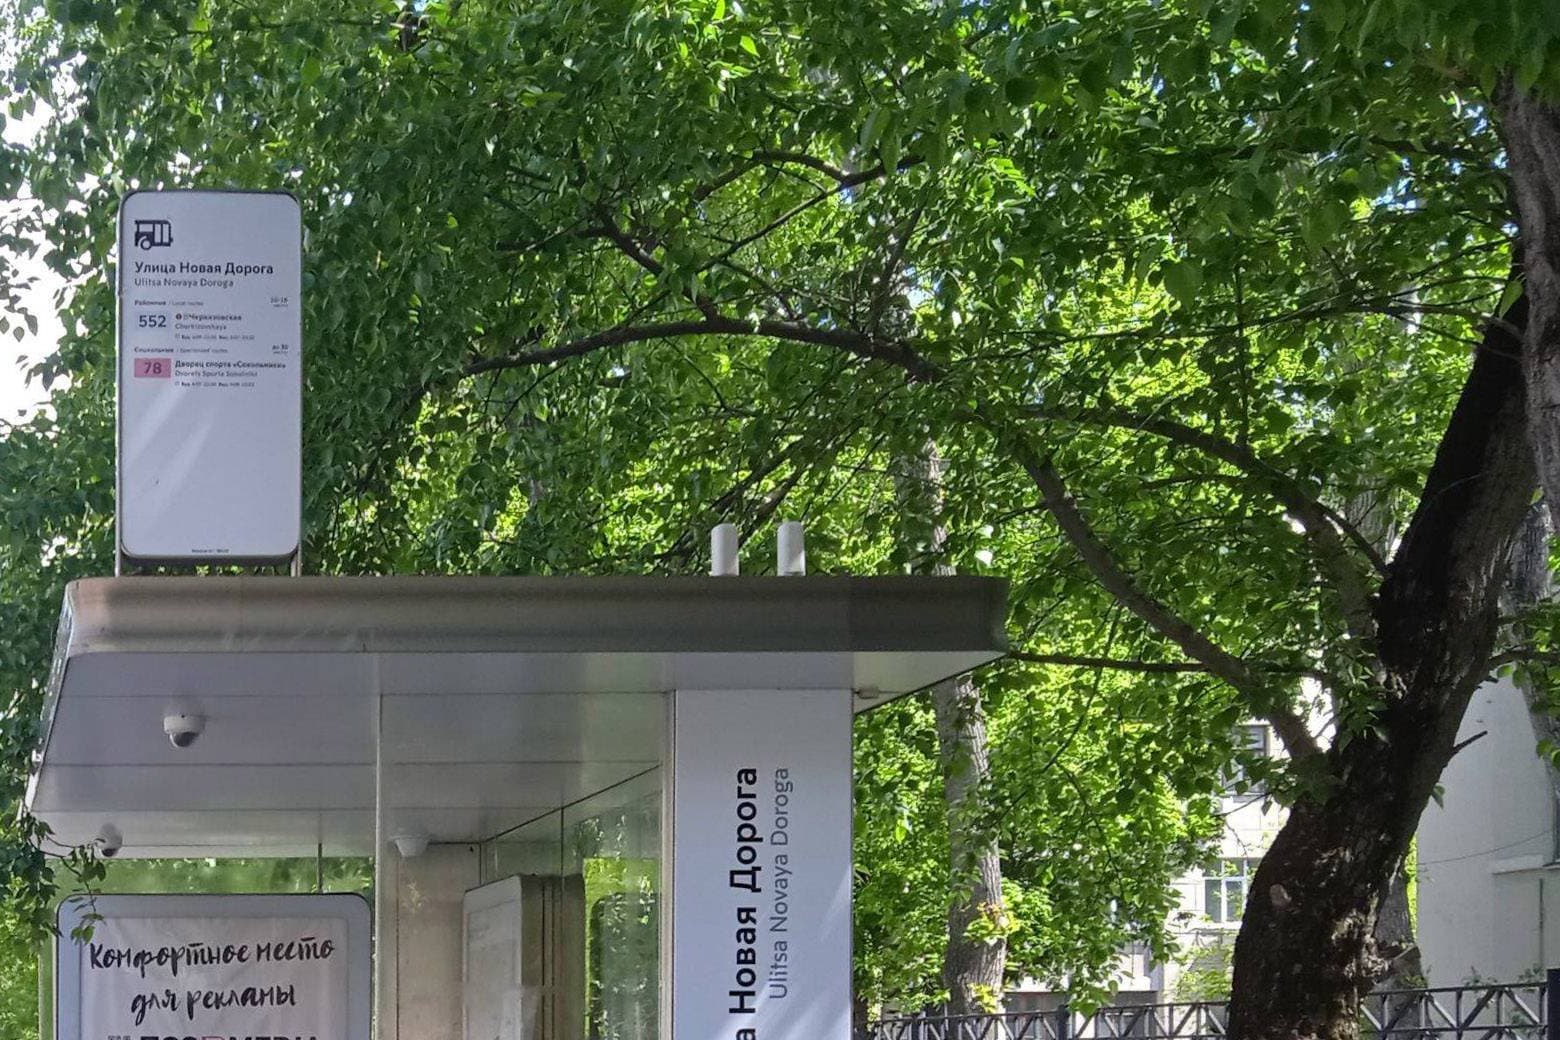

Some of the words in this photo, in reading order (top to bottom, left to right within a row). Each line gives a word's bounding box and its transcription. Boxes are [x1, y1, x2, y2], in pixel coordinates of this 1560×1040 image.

[134, 261, 176, 275] Улица
[179, 262, 222, 274] Новая
[224, 262, 274, 276] Дорога
[134, 278, 161, 287] Ulitsa
[163, 278, 198, 289] Novaya
[200, 279, 234, 289] Doroga
[138, 314, 167, 328] 552
[142, 362, 162, 375] 78
[175, 360, 204, 369] Дворец
[770, 767, 795, 847] Doroga
[729, 767, 764, 894] Дорога
[769, 855, 793, 933] Novaya
[89, 941, 250, 978] Комфортное
[255, 936, 336, 963] место
[729, 906, 758, 1015] Новая
[768, 940, 788, 1000] Ulitsa
[130, 988, 179, 1026] для
[187, 983, 297, 1021] рекламы
